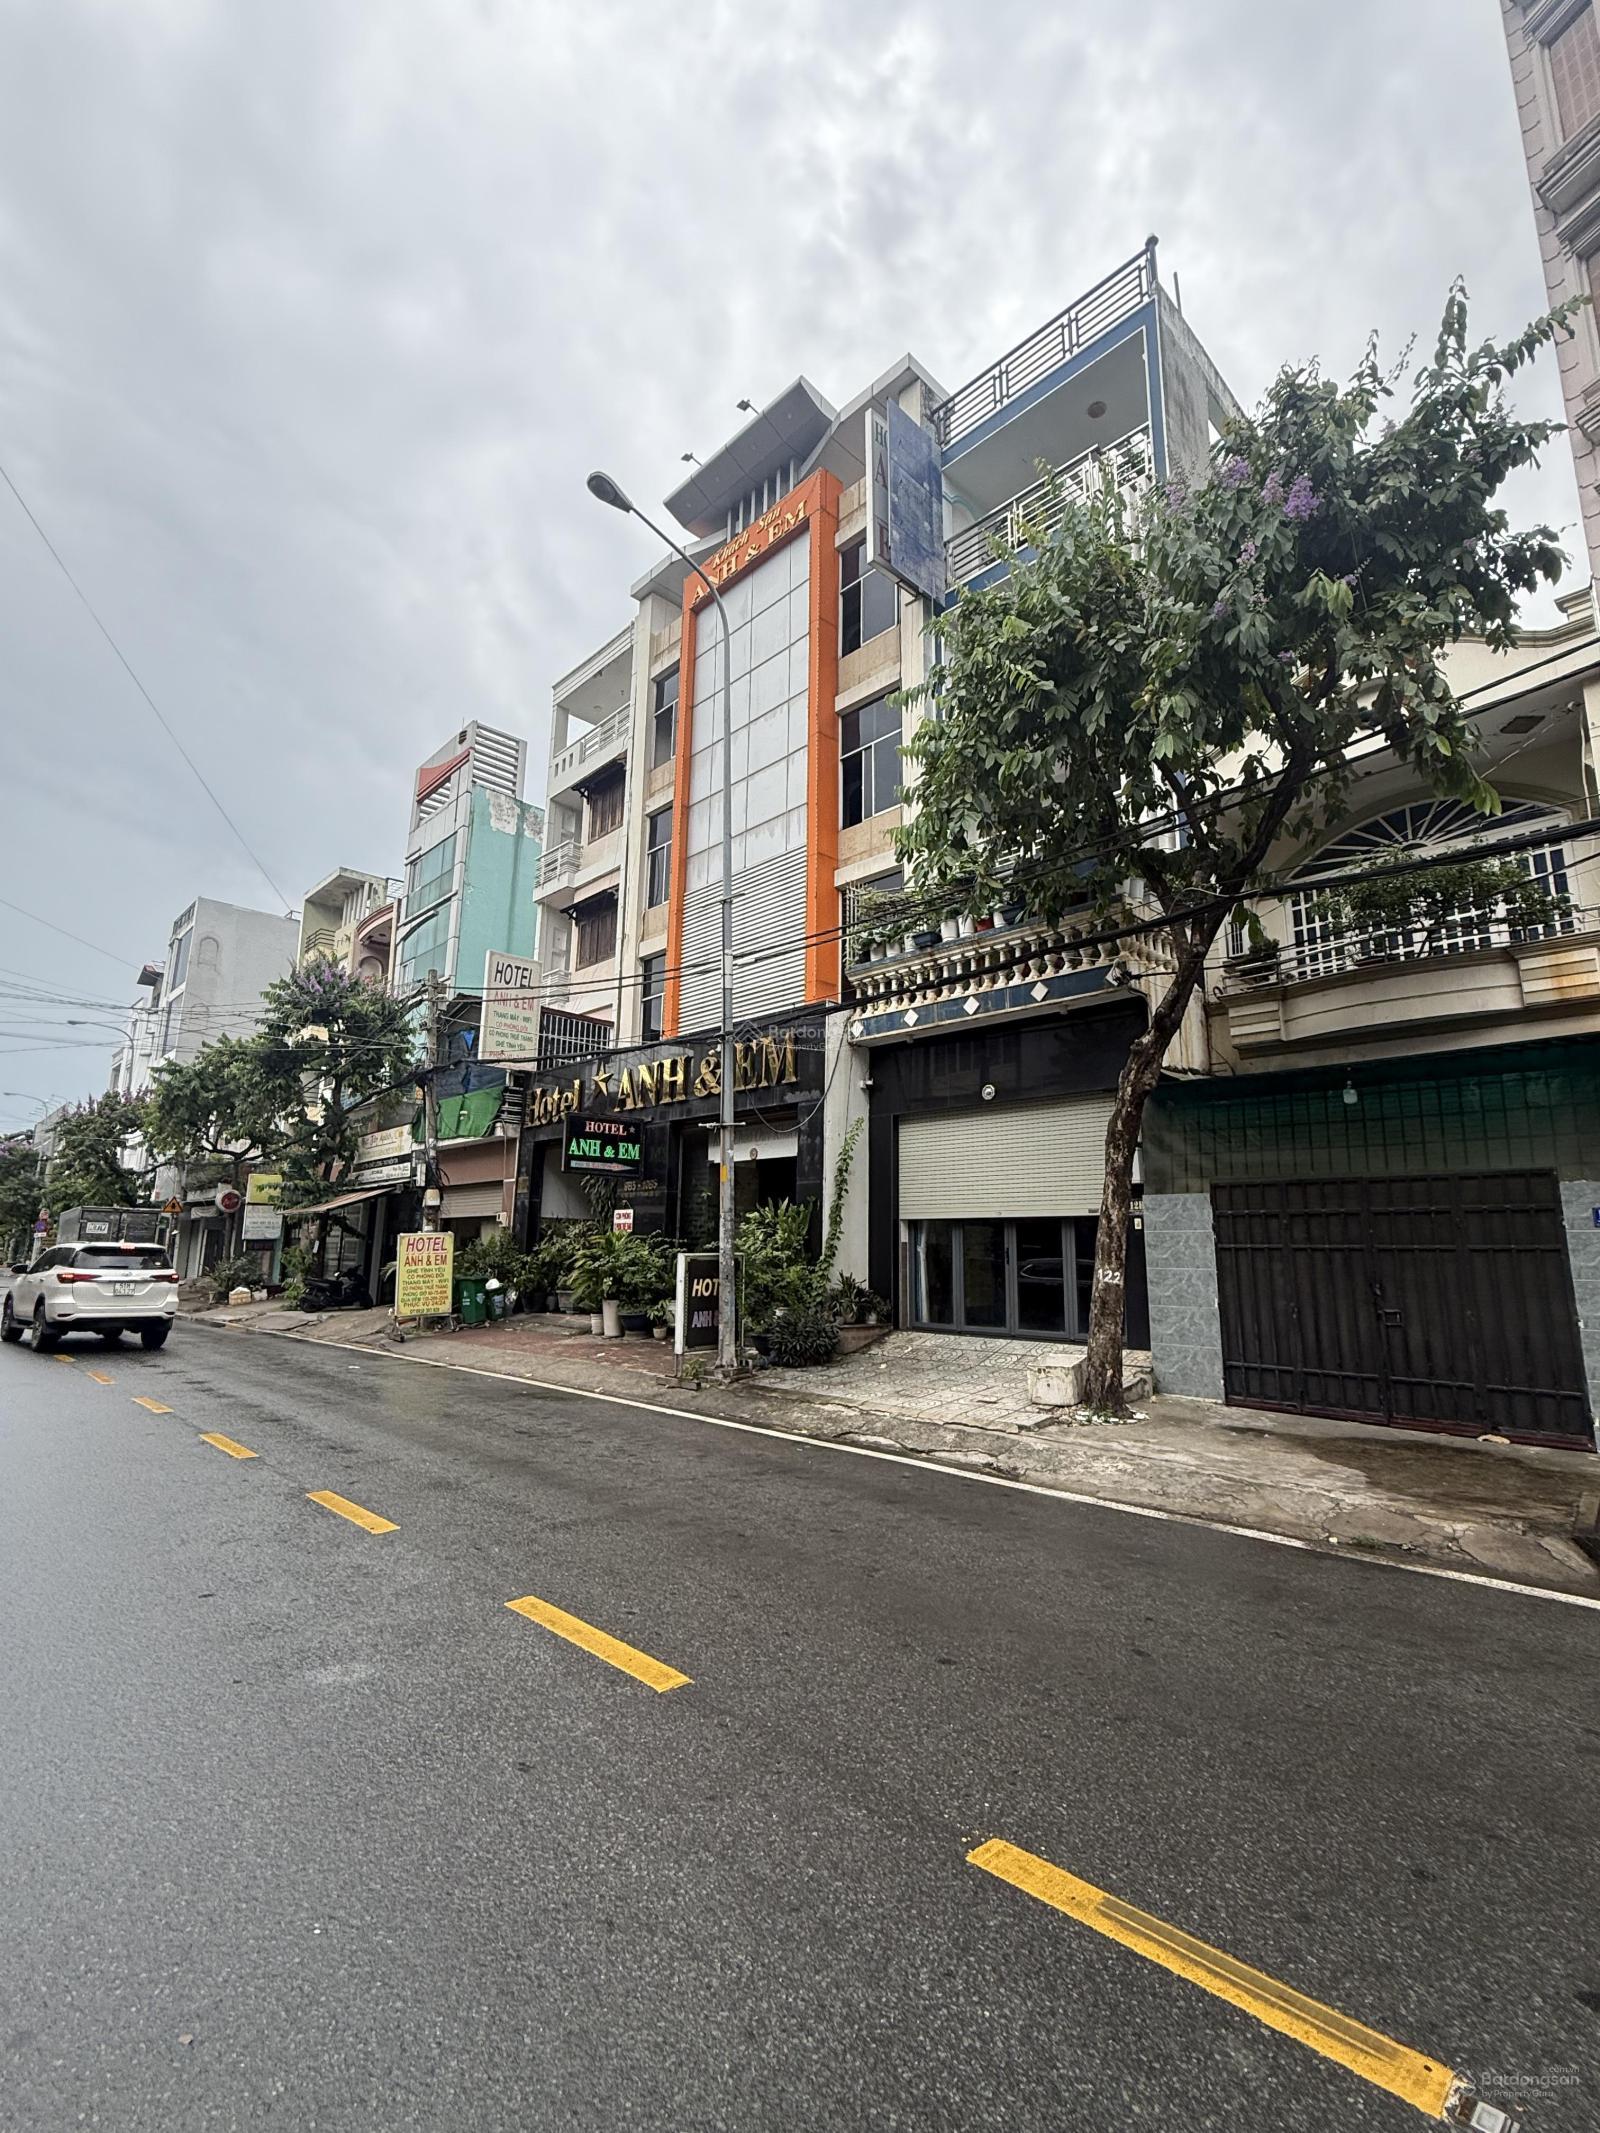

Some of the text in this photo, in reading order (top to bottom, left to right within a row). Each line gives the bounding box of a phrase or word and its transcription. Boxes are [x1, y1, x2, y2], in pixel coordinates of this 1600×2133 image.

[692, 500, 807, 604] ANH & EM
[494, 961, 533, 988] HOTEL
[522, 996, 534, 1011] EM
[524, 1035, 798, 1127] Hotel ANH & EM
[585, 1121, 627, 1136] HOTEL
[568, 1137, 640, 1160] ANH & EM
[406, 1236, 447, 1252] HOTEL
[404, 1254, 447, 1267] ANH & EM
[1098, 1269, 1121, 1285] 122
[692, 1311, 712, 1328] ANH
